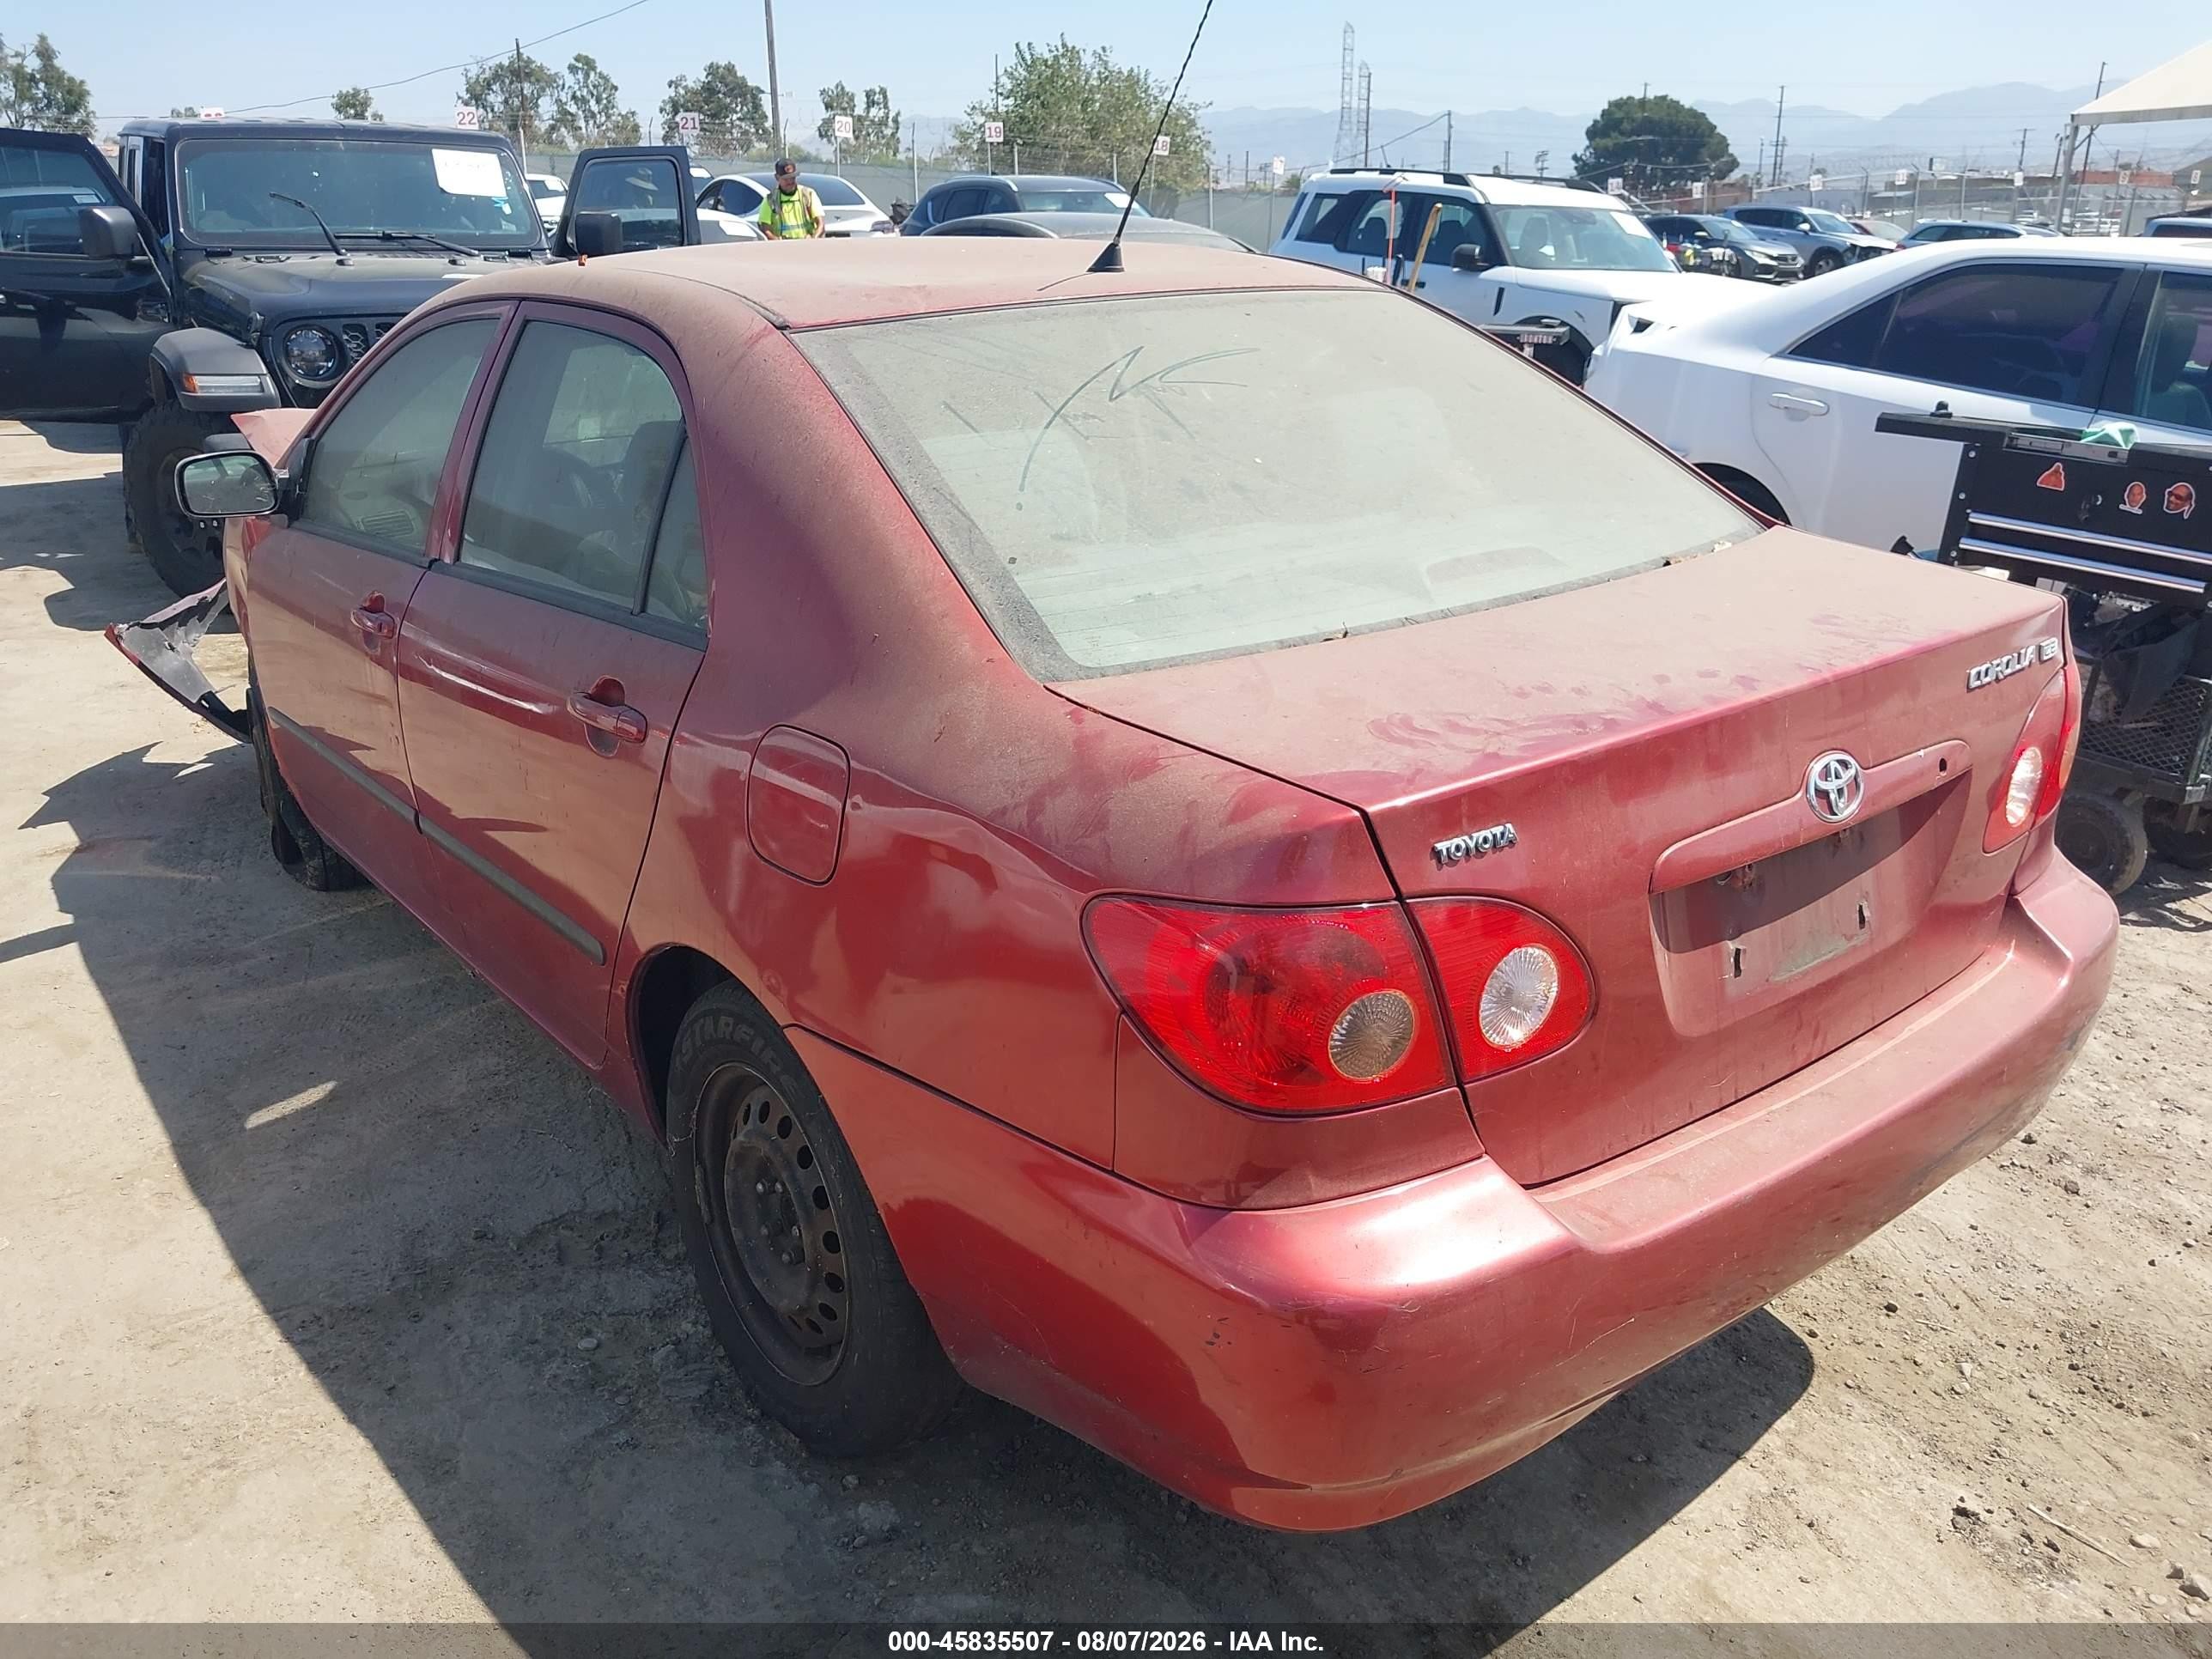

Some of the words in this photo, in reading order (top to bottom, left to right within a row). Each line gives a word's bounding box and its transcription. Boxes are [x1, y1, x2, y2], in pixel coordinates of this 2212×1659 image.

[456, 111, 477, 125] 22
[680, 116, 698, 130] 21
[836, 120, 851, 133] 20
[987, 125, 1002, 138] 19
[1154, 140, 1168, 151] 18
[1433, 823, 1518, 865] TOYOTA
